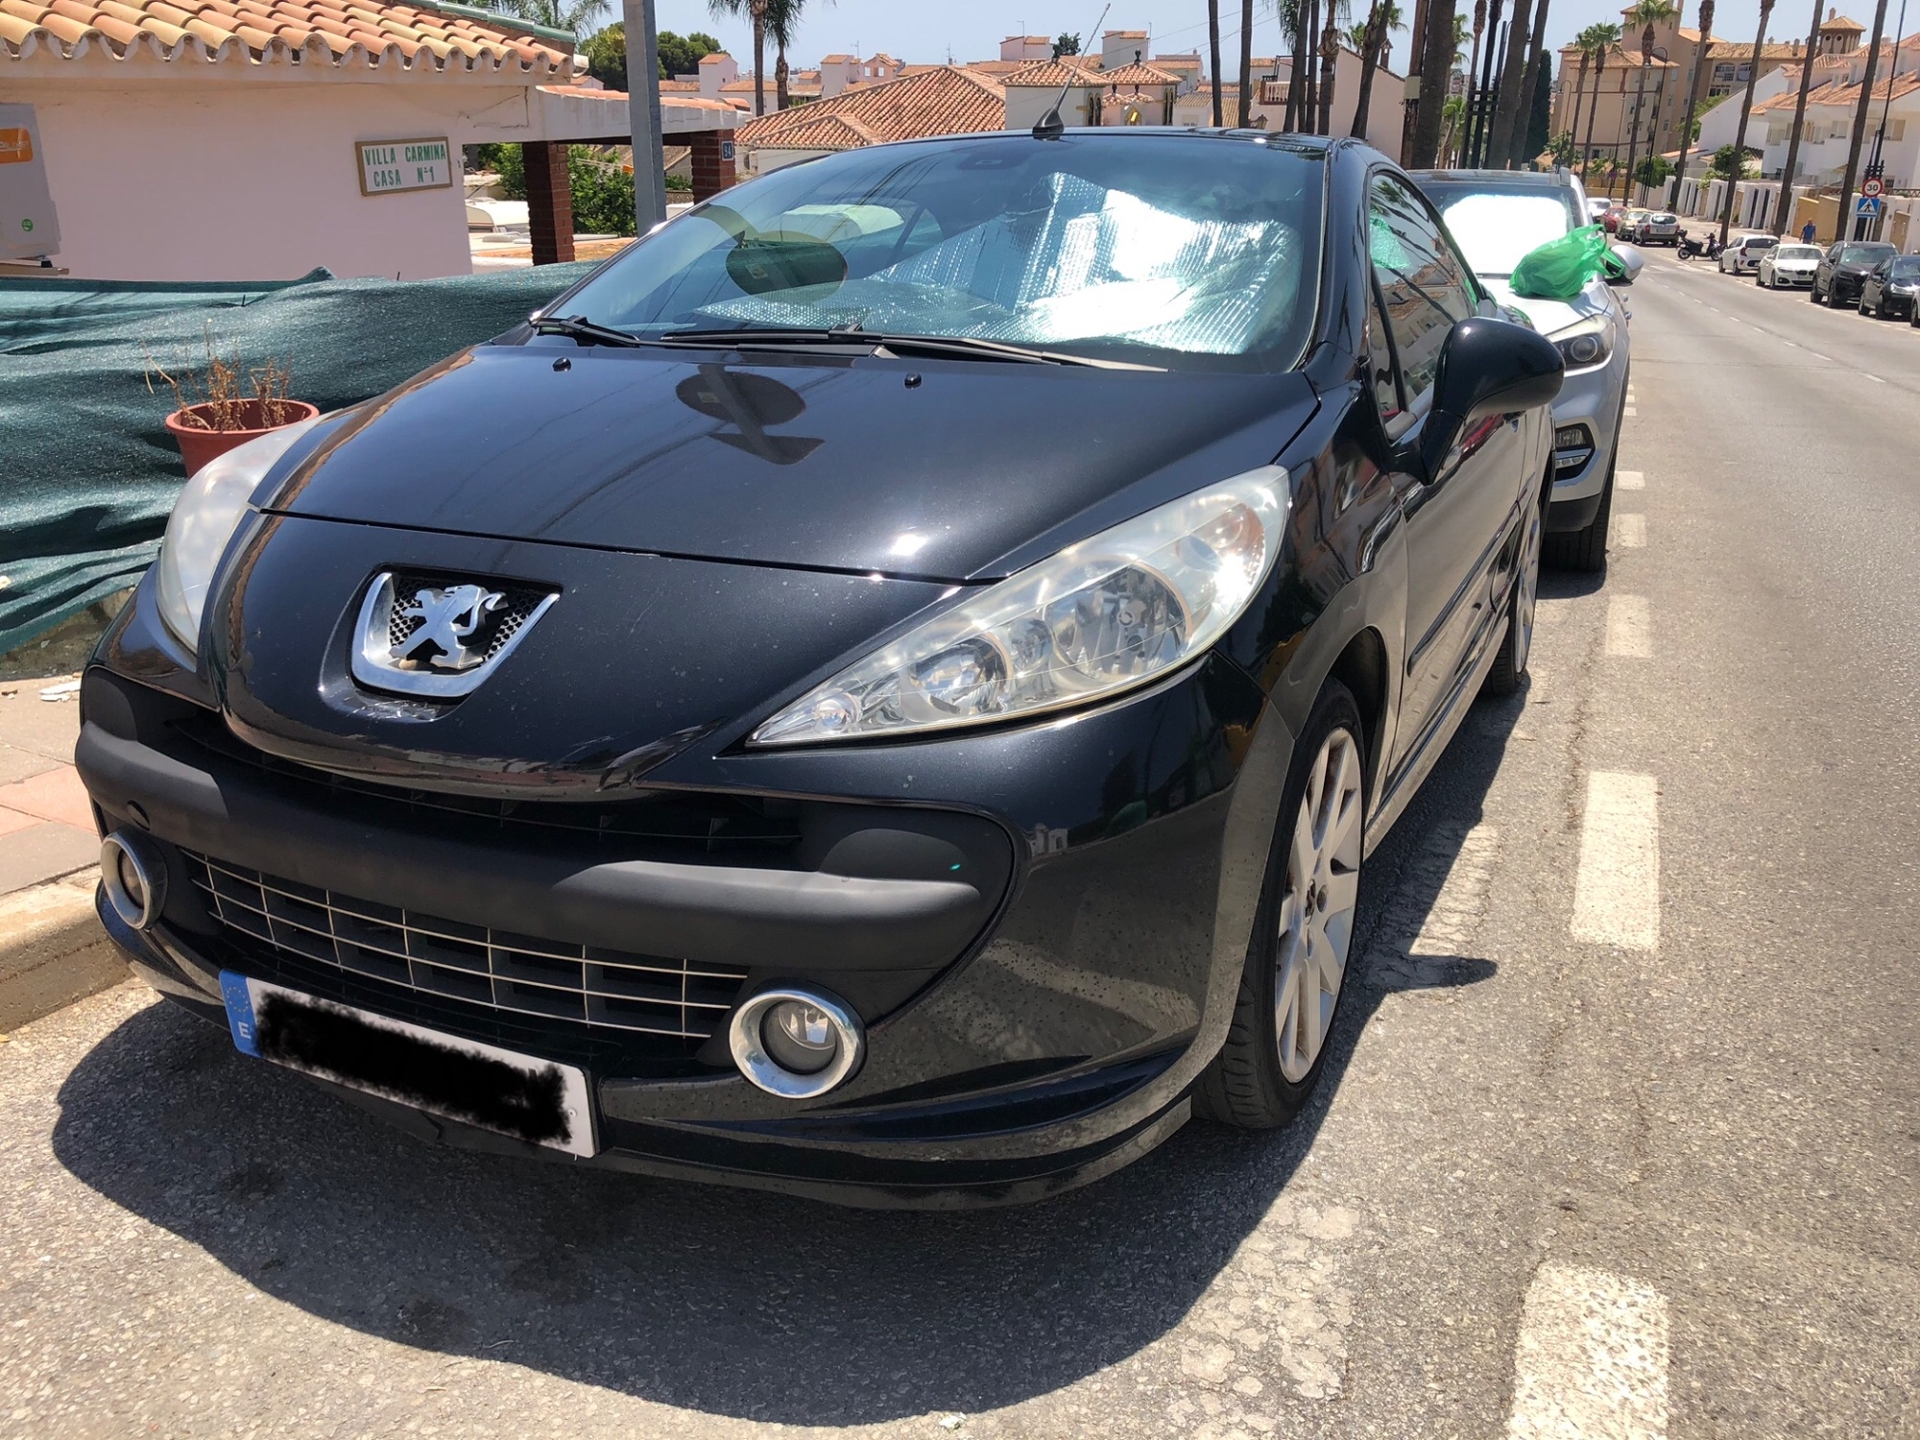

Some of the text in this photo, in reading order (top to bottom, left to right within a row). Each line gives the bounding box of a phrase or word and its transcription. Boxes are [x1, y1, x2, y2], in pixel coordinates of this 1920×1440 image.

[364, 144, 446, 166] VILLA CARMINA
[373, 169, 402, 187] CASA
[1866, 184, 1879, 192] 30
[237, 1021, 252, 1040] E
